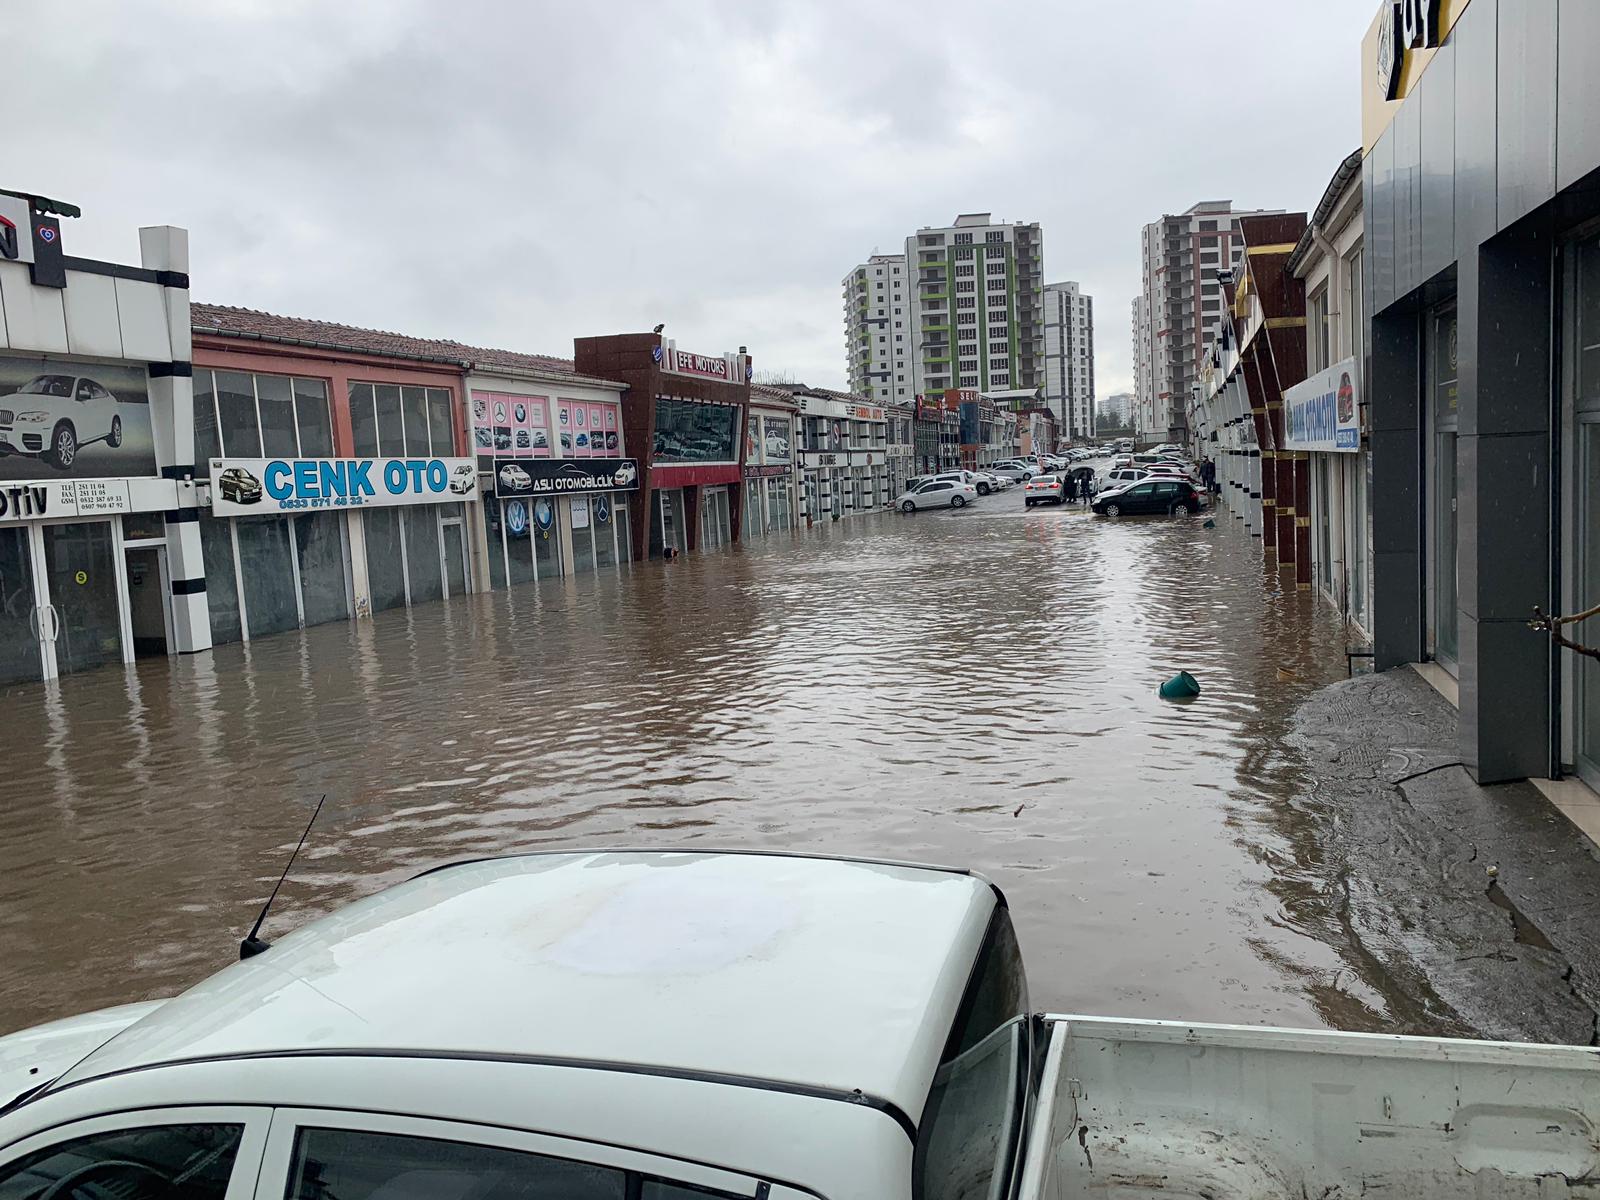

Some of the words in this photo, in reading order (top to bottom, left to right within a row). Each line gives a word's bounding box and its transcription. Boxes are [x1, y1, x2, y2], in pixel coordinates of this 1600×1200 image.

[678, 352, 693, 369] EFE
[695, 355, 725, 375] MOTORS
[264, 460, 376, 501] CENK
[383, 459, 448, 494] OTO
[533, 479, 554, 492] ASLI
